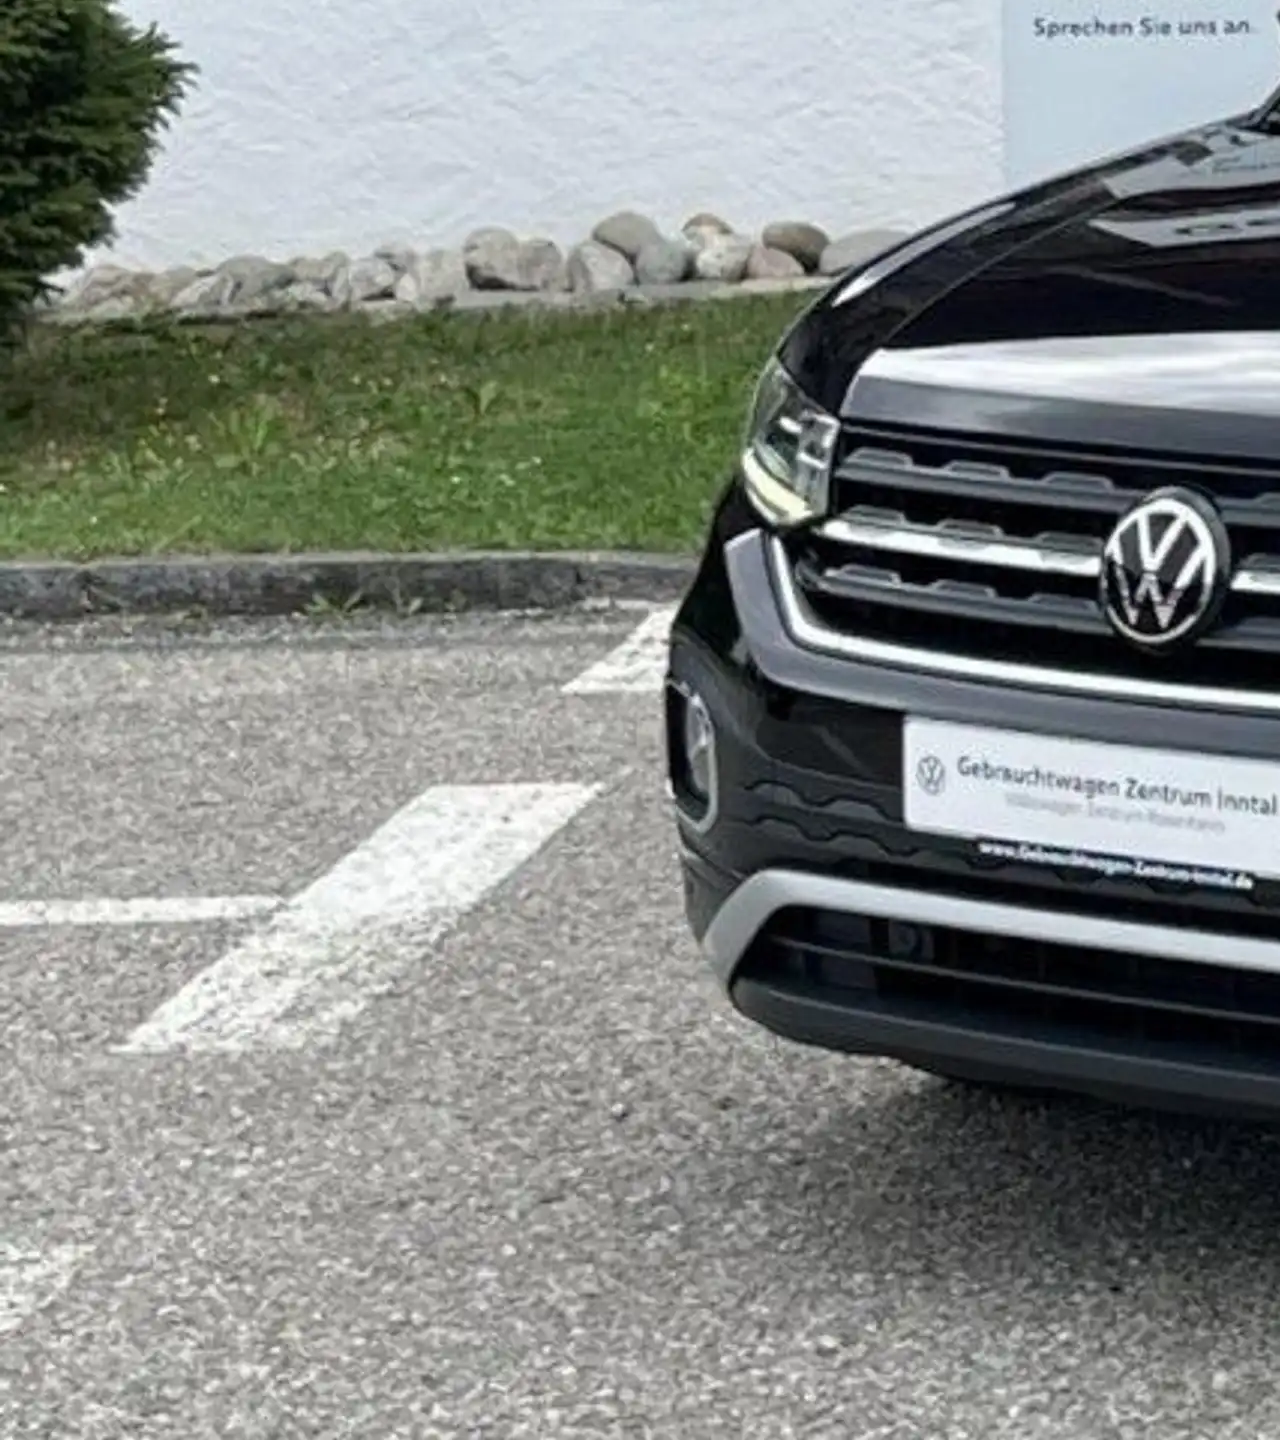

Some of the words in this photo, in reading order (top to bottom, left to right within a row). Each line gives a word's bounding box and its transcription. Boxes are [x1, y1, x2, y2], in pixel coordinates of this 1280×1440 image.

[1033, 18, 1134, 39] Sprechen
[1139, 17, 1172, 36] Sie
[1178, 22, 1217, 36] uns
[1103, 497, 1217, 644] VW
[956, 755, 1121, 800] Gebrauchtwagen
[1124, 777, 1212, 809] Zentrum
[1216, 785, 1279, 817] Inntal
